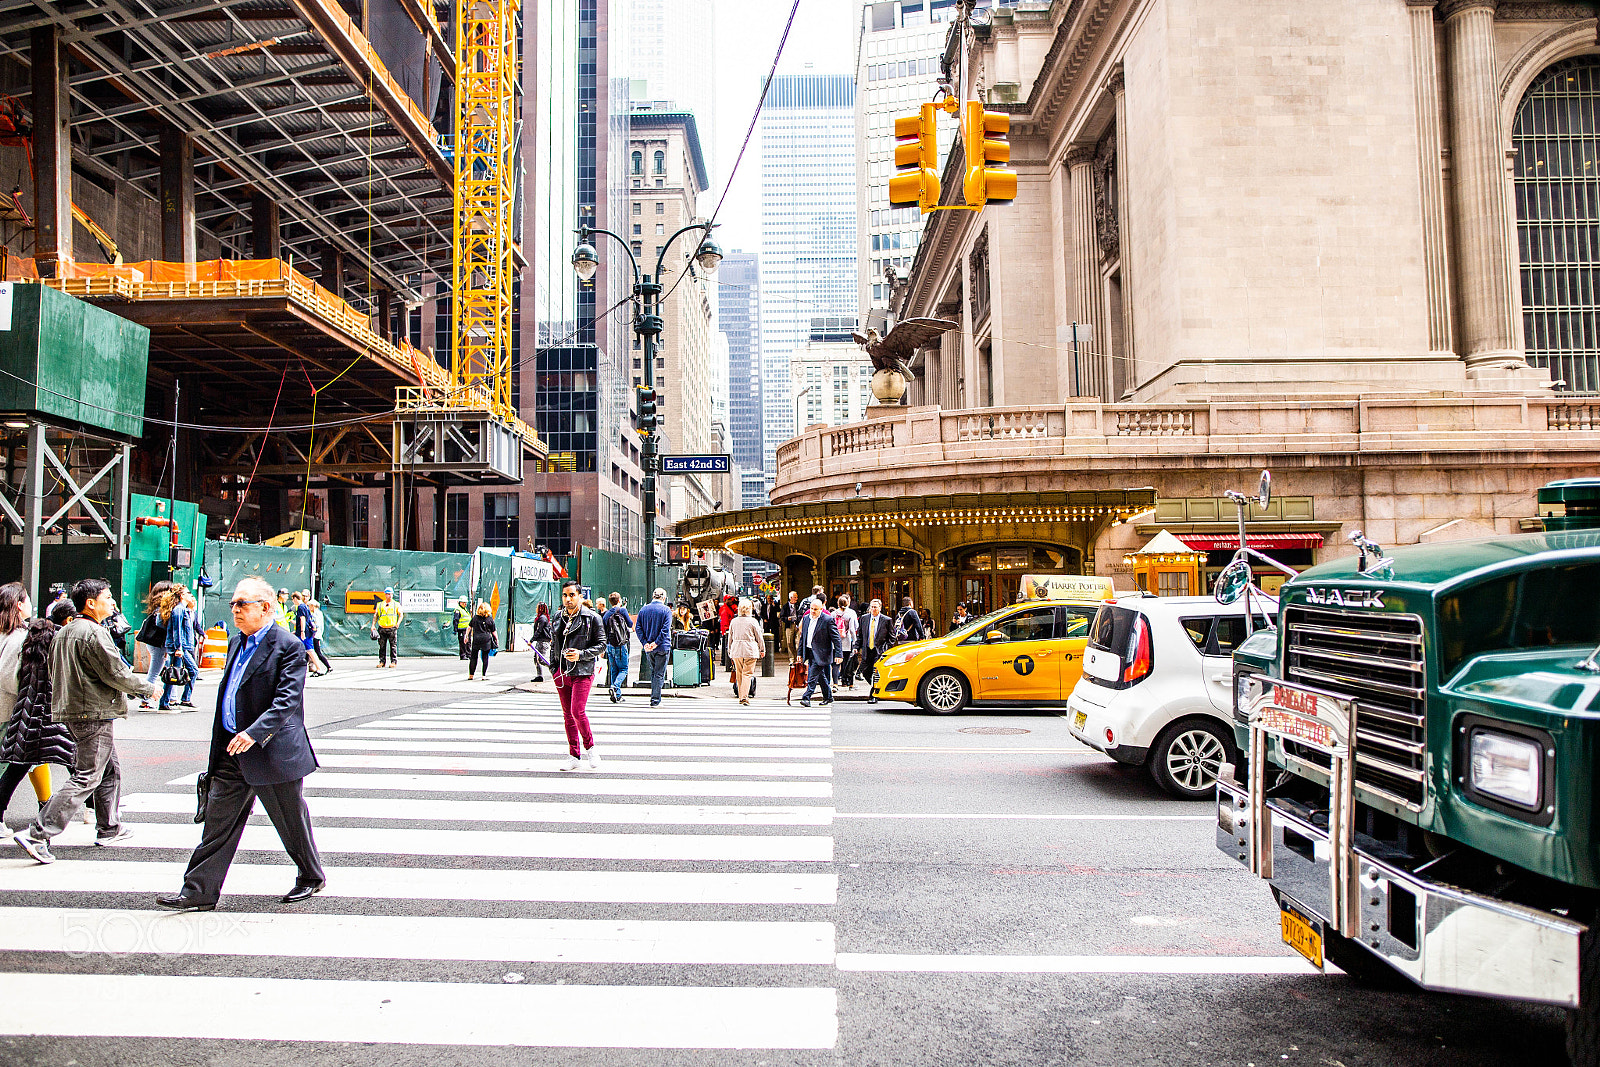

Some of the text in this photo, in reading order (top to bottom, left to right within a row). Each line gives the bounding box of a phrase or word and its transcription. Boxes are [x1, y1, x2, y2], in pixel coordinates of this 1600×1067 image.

[666, 459, 725, 469] East 42nd St
[681, 545, 690, 560] 13
[1051, 581, 1109, 591] HARRY POTTER
[1305, 587, 1386, 609] MACK
